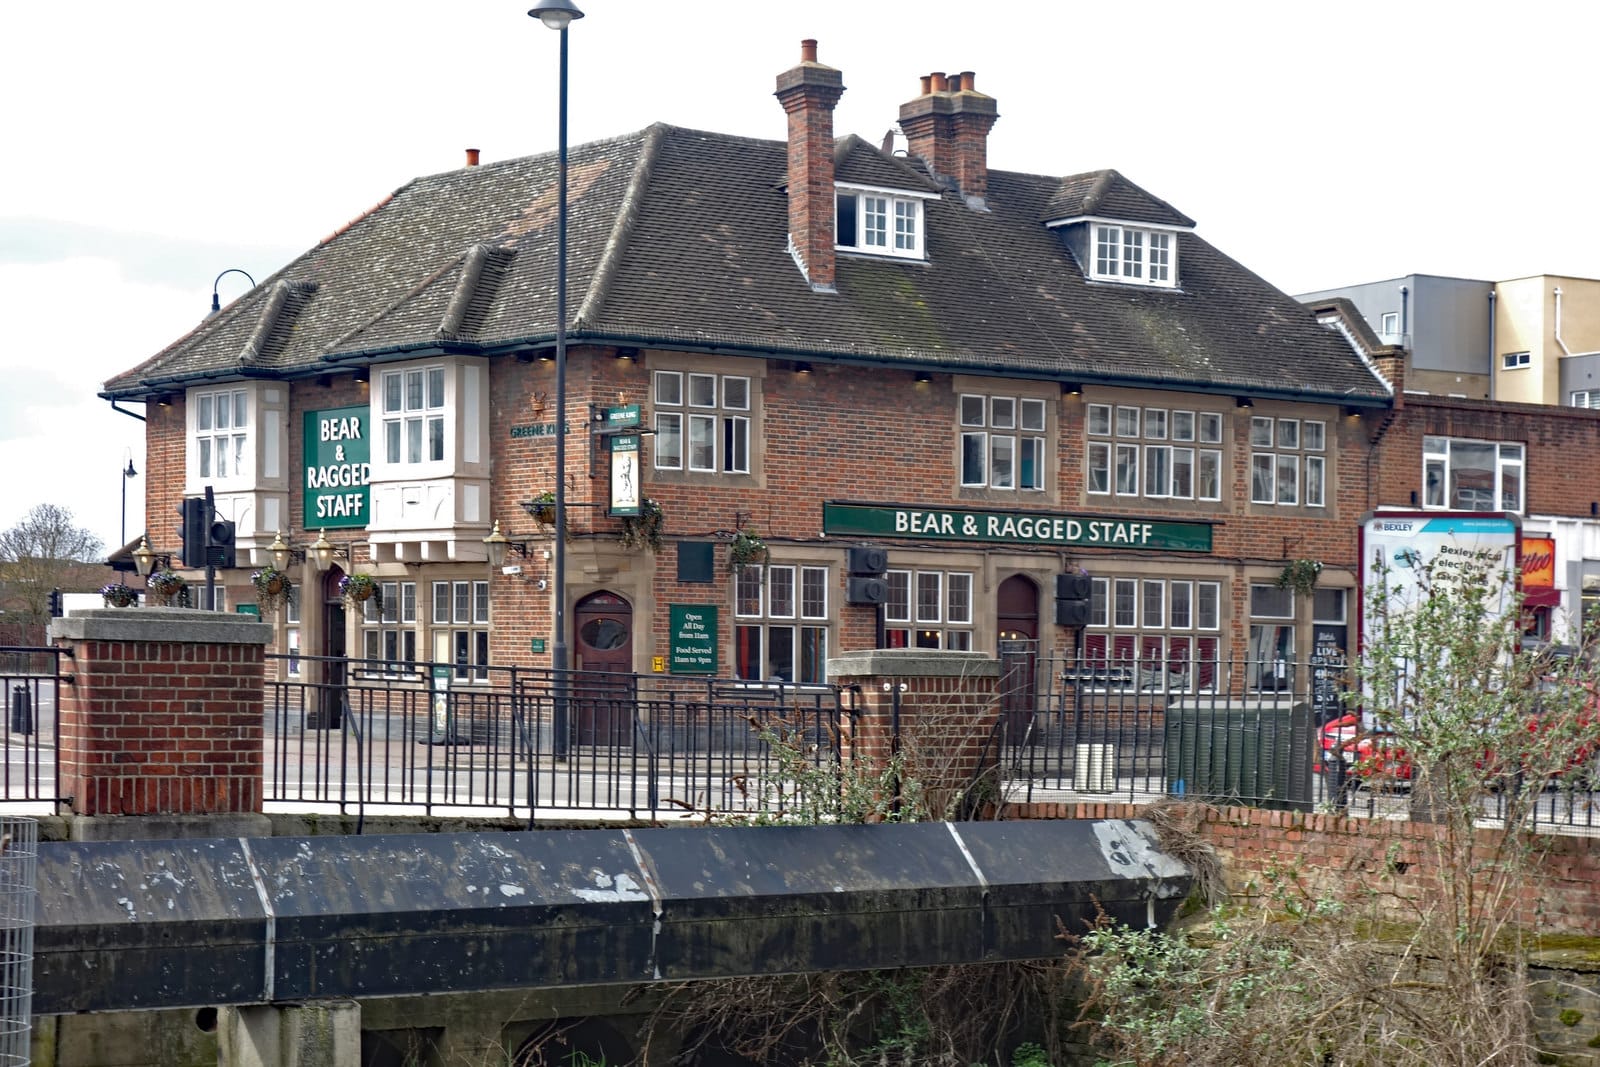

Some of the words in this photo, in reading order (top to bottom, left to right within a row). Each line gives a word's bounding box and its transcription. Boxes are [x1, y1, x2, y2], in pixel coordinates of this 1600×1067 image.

[321, 417, 361, 441] BEAR
[511, 424, 544, 438] GREENE
[546, 423, 570, 435] KIG
[335, 445, 345, 461] &
[307, 463, 371, 488] RAGGED
[317, 493, 362, 517] STAFF
[896, 511, 955, 535] BEAR
[962, 515, 978, 536] &
[987, 516, 1082, 541] RAGGED
[1088, 521, 1153, 544] STAFF
[1441, 545, 1474, 558] Bexley
[685, 613, 702, 621] Open
[1316, 647, 1338, 656] LIVE
